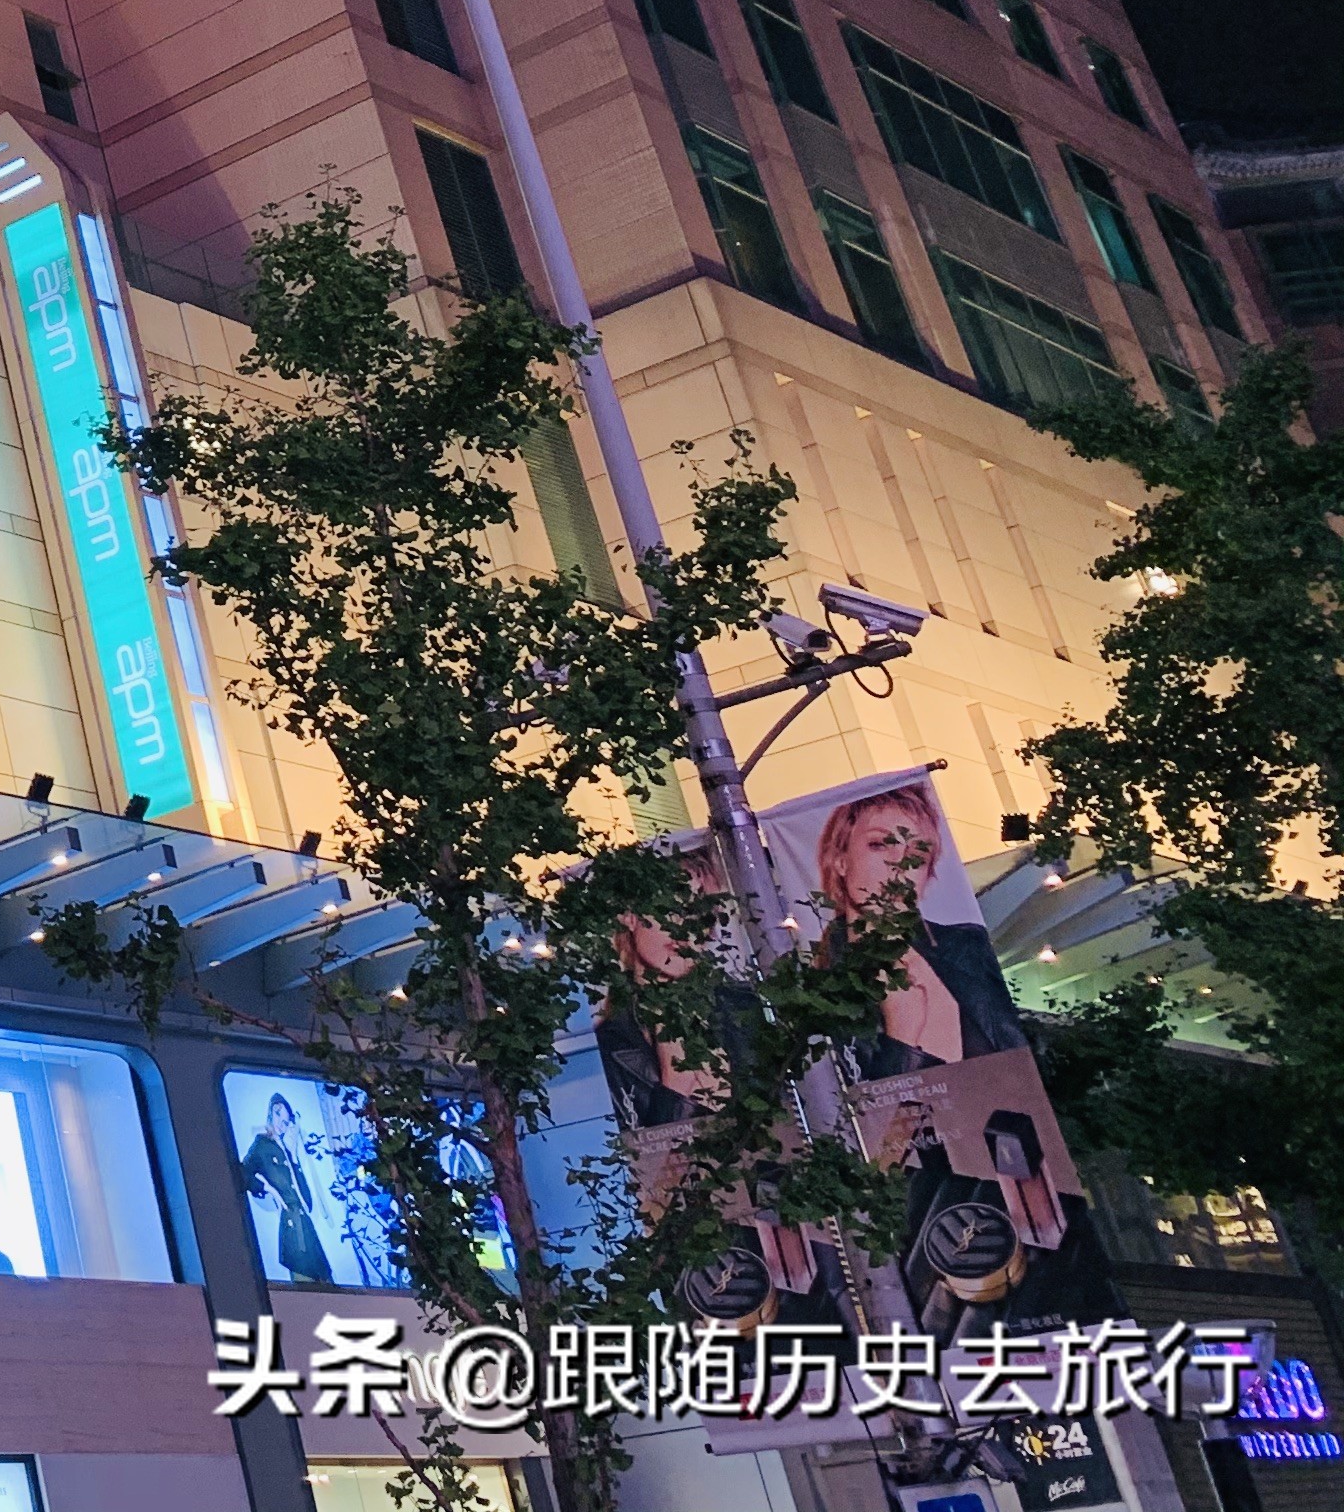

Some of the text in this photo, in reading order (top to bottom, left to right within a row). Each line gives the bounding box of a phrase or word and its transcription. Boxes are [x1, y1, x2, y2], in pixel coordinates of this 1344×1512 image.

[29, 261, 76, 372] apm
[69, 443, 120, 561] apm
[112, 640, 165, 765] apm
[872, 1076, 923, 1095] CUSHION
[1236, 1359, 1325, 1419] ADO
[1047, 1421, 1088, 1450] 24
[1238, 1430, 1341, 1457] WITZERLAND
